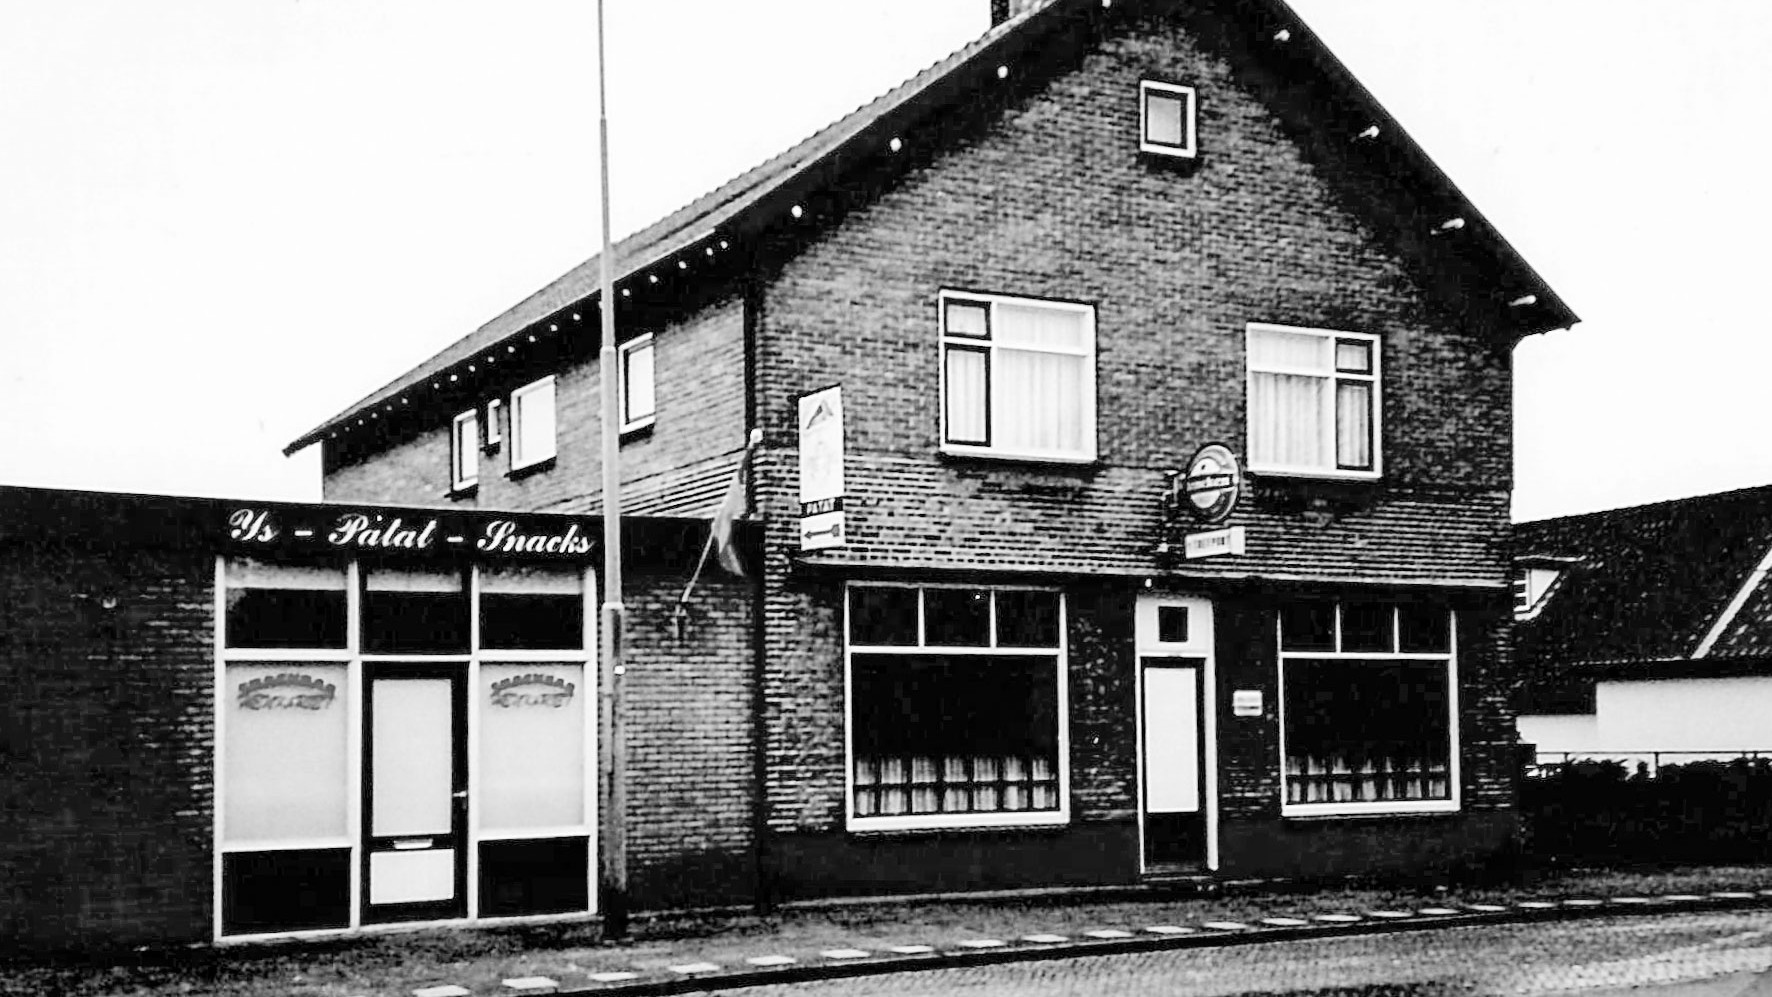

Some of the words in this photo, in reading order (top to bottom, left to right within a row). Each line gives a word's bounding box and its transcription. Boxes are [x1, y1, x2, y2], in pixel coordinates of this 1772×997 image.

[806, 498, 836, 515] PATAT
[228, 508, 279, 542] Ys
[476, 520, 595, 554] Snacks
